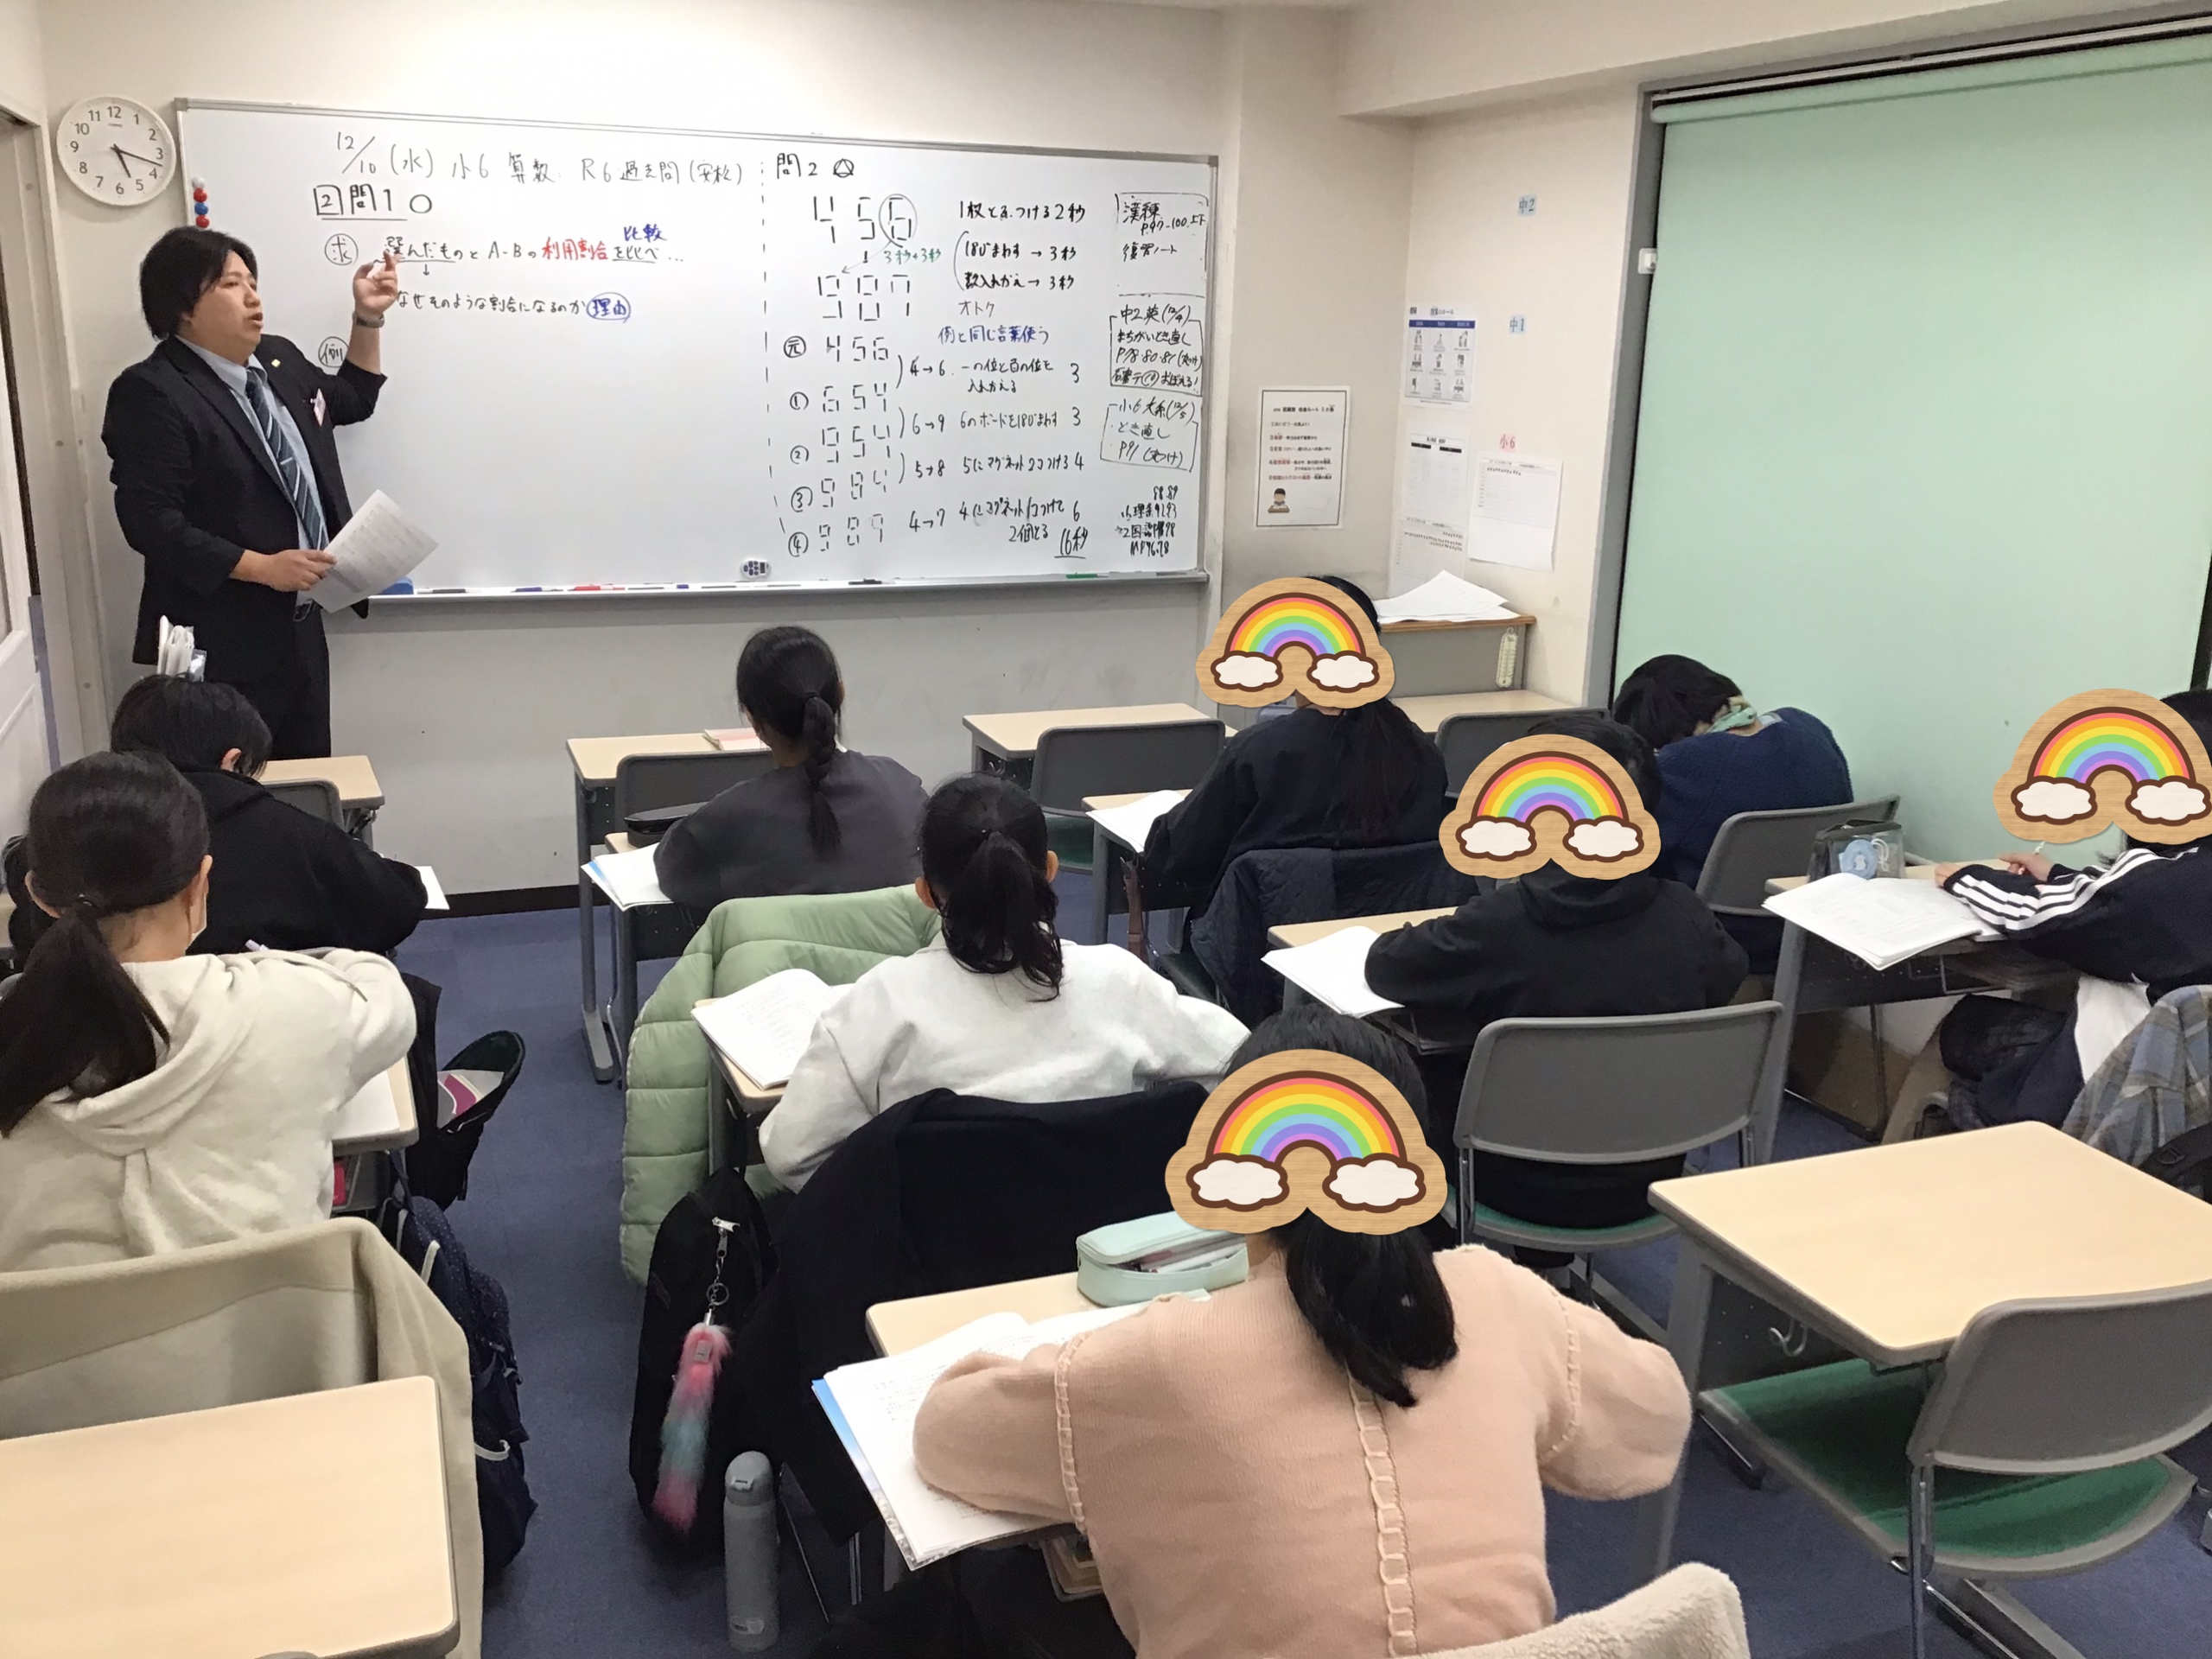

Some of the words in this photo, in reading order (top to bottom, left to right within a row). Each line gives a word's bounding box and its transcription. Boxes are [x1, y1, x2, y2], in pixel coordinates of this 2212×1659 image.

[88, 110, 101, 122] 11
[106, 105, 122, 118] 12
[133, 113, 139, 125] 1
[74, 123, 90, 135] 10
[148, 128, 157, 141] 2
[70, 140, 79, 153] 9
[156, 147, 164, 160] 3
[337, 131, 376, 174] 12/10
[391, 143, 433, 178] (水)
[452, 153, 489, 179] 小6
[509, 151, 556, 184] 算数
[79, 162, 88, 174] 8
[149, 168, 158, 179] 4
[95, 175, 104, 188] 7
[116, 182, 124, 194] 6
[136, 179, 144, 191] 5
[1518, 197, 1535, 214] 中2
[623, 223, 668, 244] 比較
[588, 296, 629, 319] 理由
[958, 300, 995, 318] オトク
[1510, 316, 1525, 334] 中1
[1499, 434, 1516, 449] 小6
